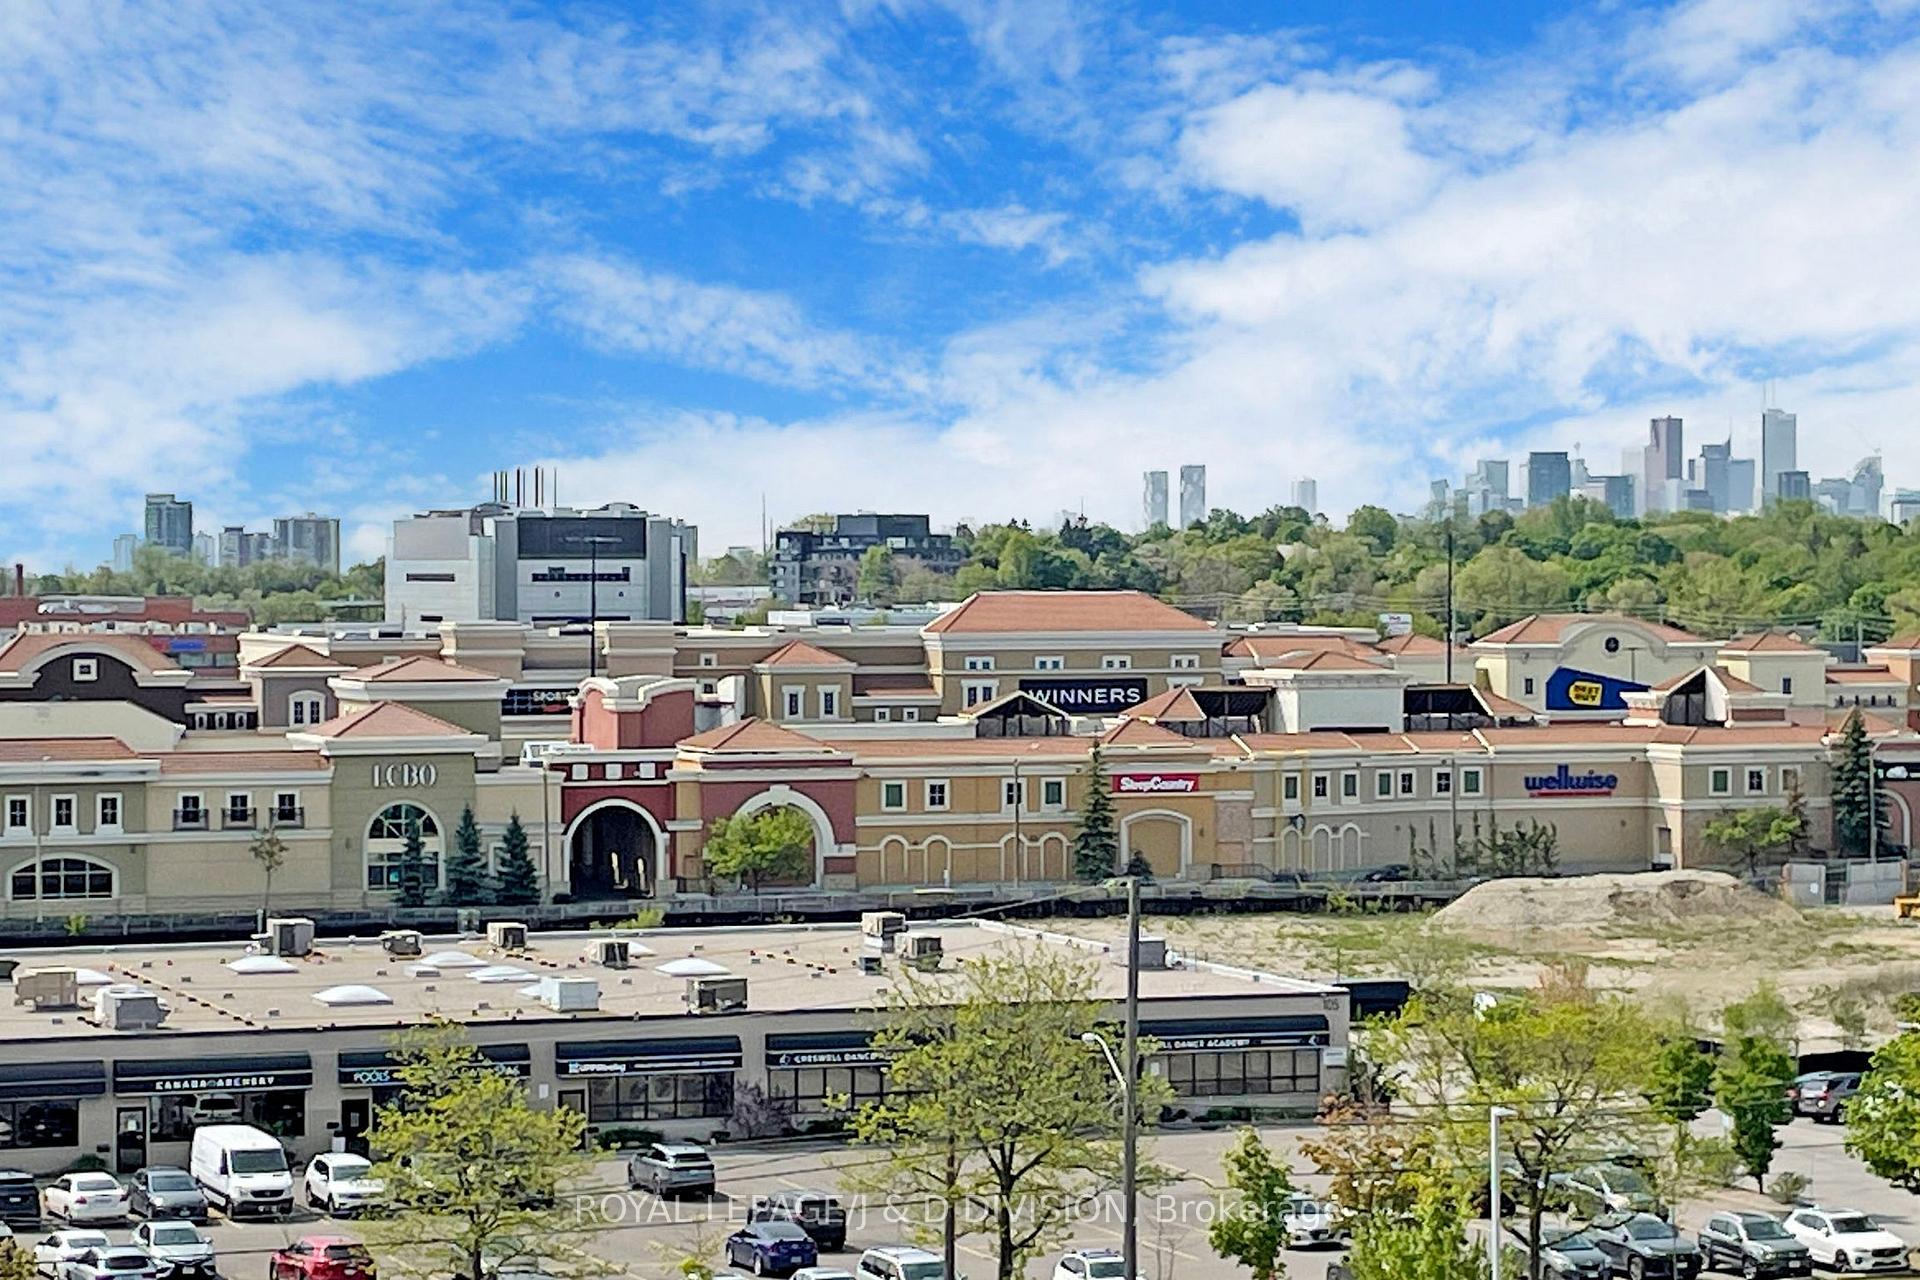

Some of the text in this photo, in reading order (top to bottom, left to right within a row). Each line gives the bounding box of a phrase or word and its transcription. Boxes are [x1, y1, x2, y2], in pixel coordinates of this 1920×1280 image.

[1028, 688, 1141, 703] WINNERS
[374, 763, 437, 787] LCBO
[1524, 764, 1618, 790] wellwise
